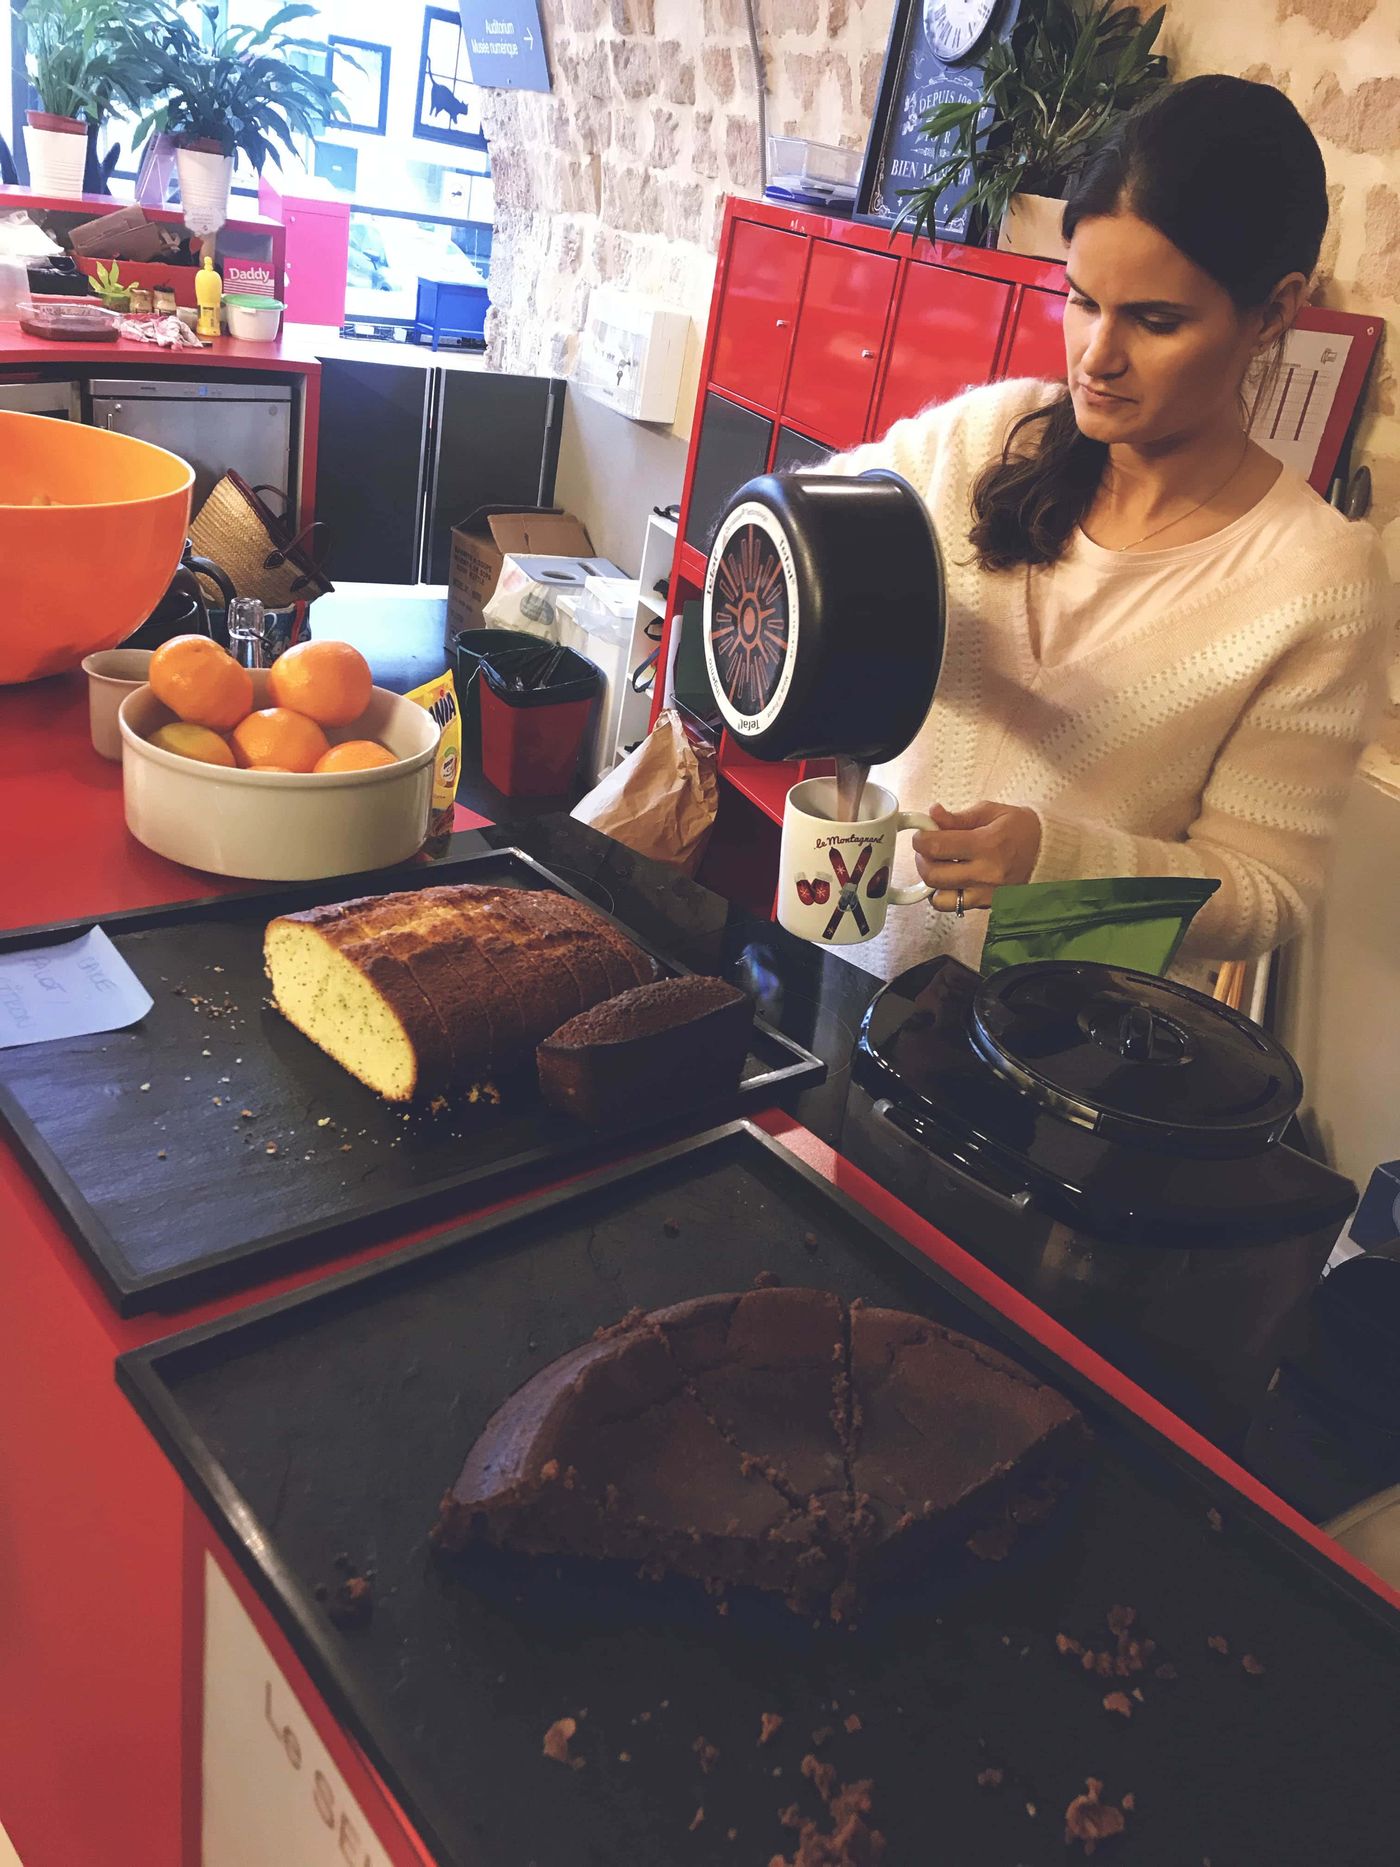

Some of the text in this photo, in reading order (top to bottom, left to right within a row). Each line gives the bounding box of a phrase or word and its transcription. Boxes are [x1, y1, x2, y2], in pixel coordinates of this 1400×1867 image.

[919, 90, 956, 114] DEPUIS
[891, 159, 919, 179] BIEN
[228, 266, 270, 283] Daddy
[826, 833, 885, 847] Montagnard
